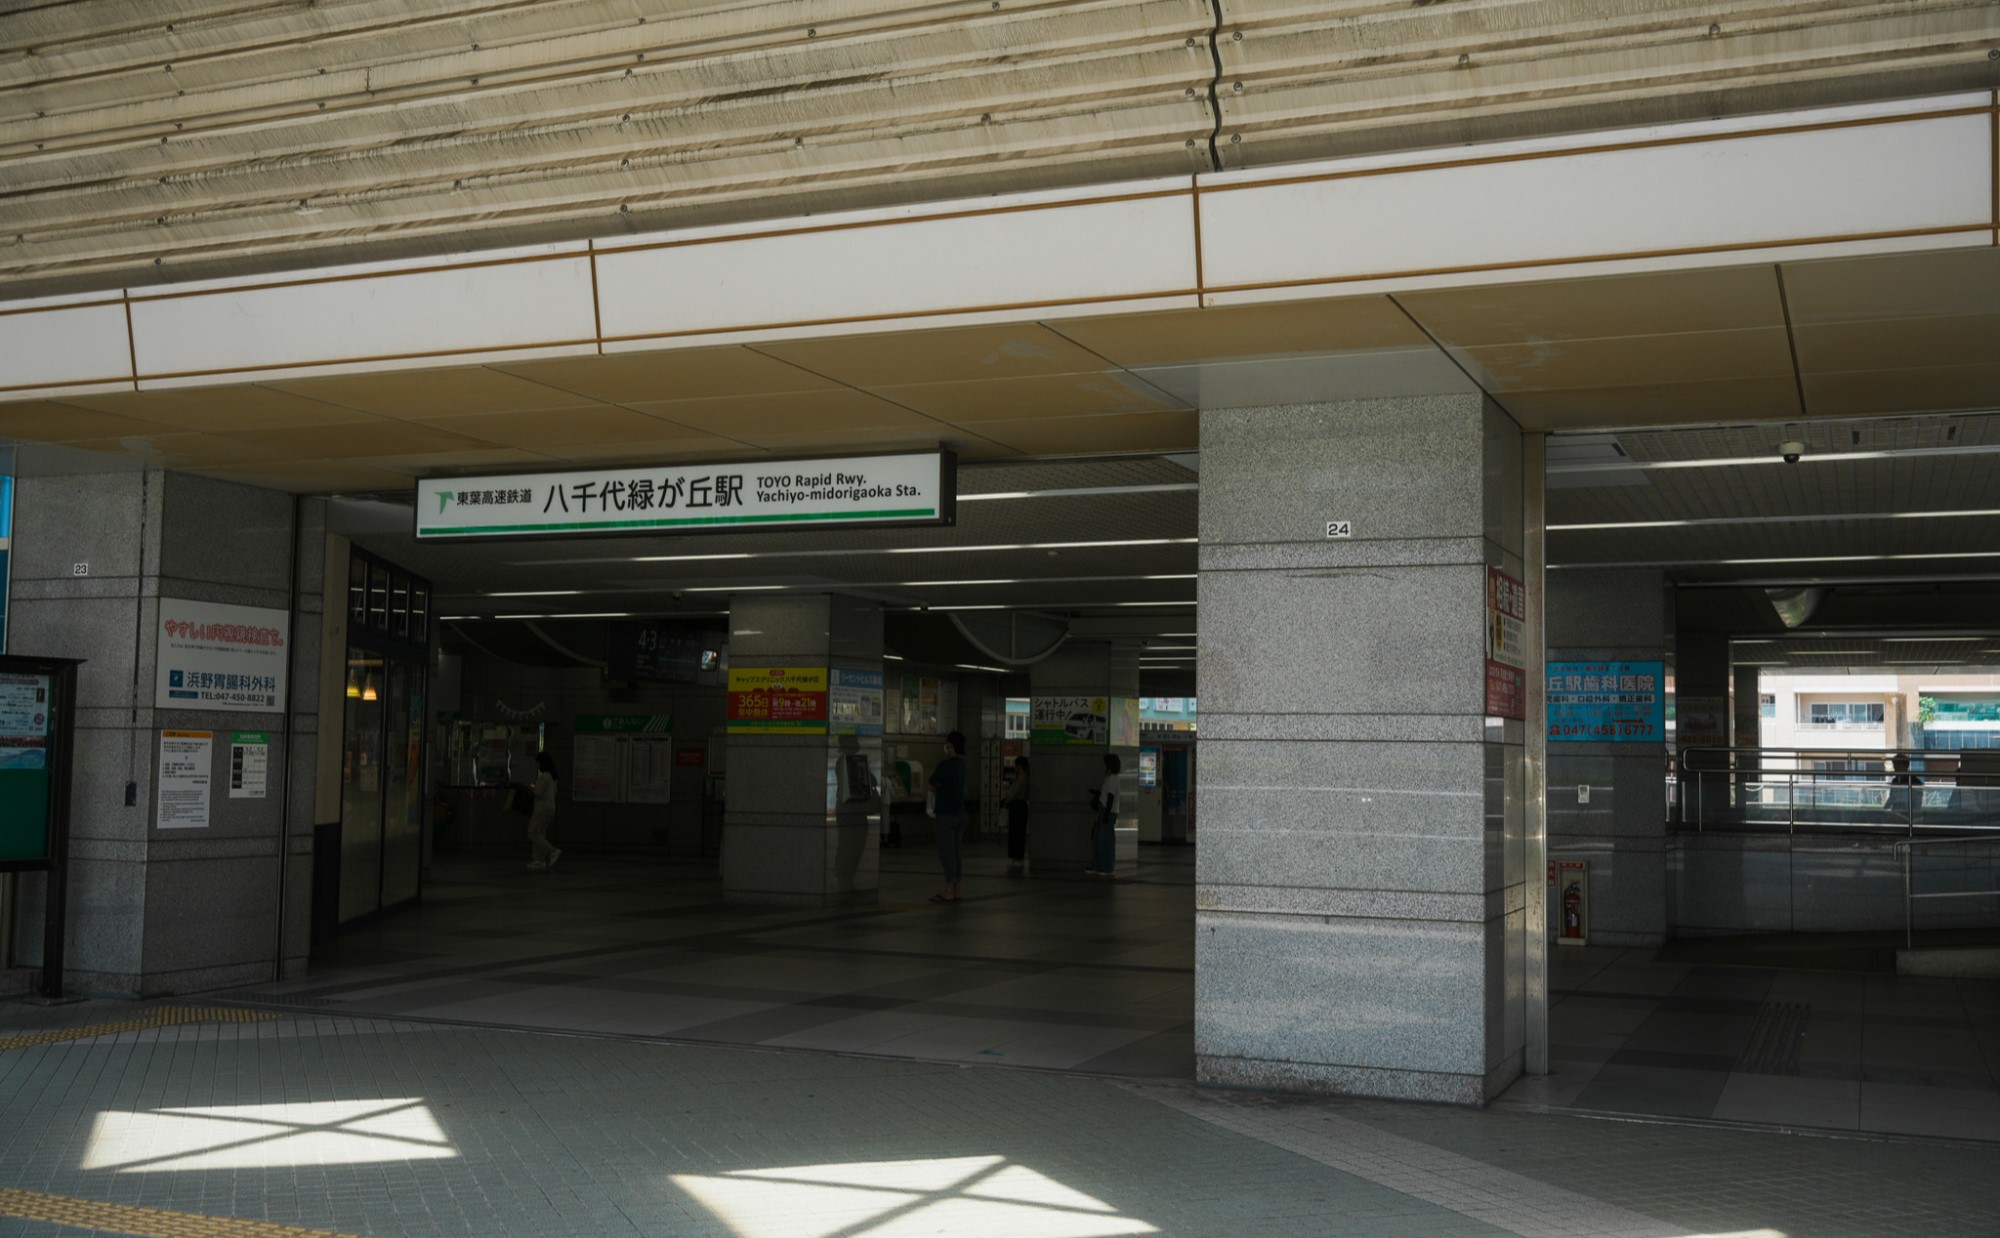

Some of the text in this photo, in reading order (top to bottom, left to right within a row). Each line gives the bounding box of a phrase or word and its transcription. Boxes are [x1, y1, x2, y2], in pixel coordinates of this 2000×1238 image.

[757, 472, 867, 489] TOYO Rapid Rwy.
[456, 488, 532, 506] 東葉高速鉄道
[543, 475, 743, 514] 八千代緑が丘駅
[757, 484, 921, 504] Yachiyo-midorigaoka Sta.
[1328, 523, 1349, 536] 24
[75, 564, 87, 574] 23
[165, 619, 284, 647] やさしい内視鏡検査を。
[187, 671, 276, 692] 浜野胃腸科外科
[1547, 674, 1656, 692] 丘駅歯科医院
[201, 691, 265, 703] TEL:047-450-8822
[738, 694, 769, 707] 365日
[1034, 698, 1089, 708] シャトルバス
[1563, 724, 1654, 736] 047(458)6777
